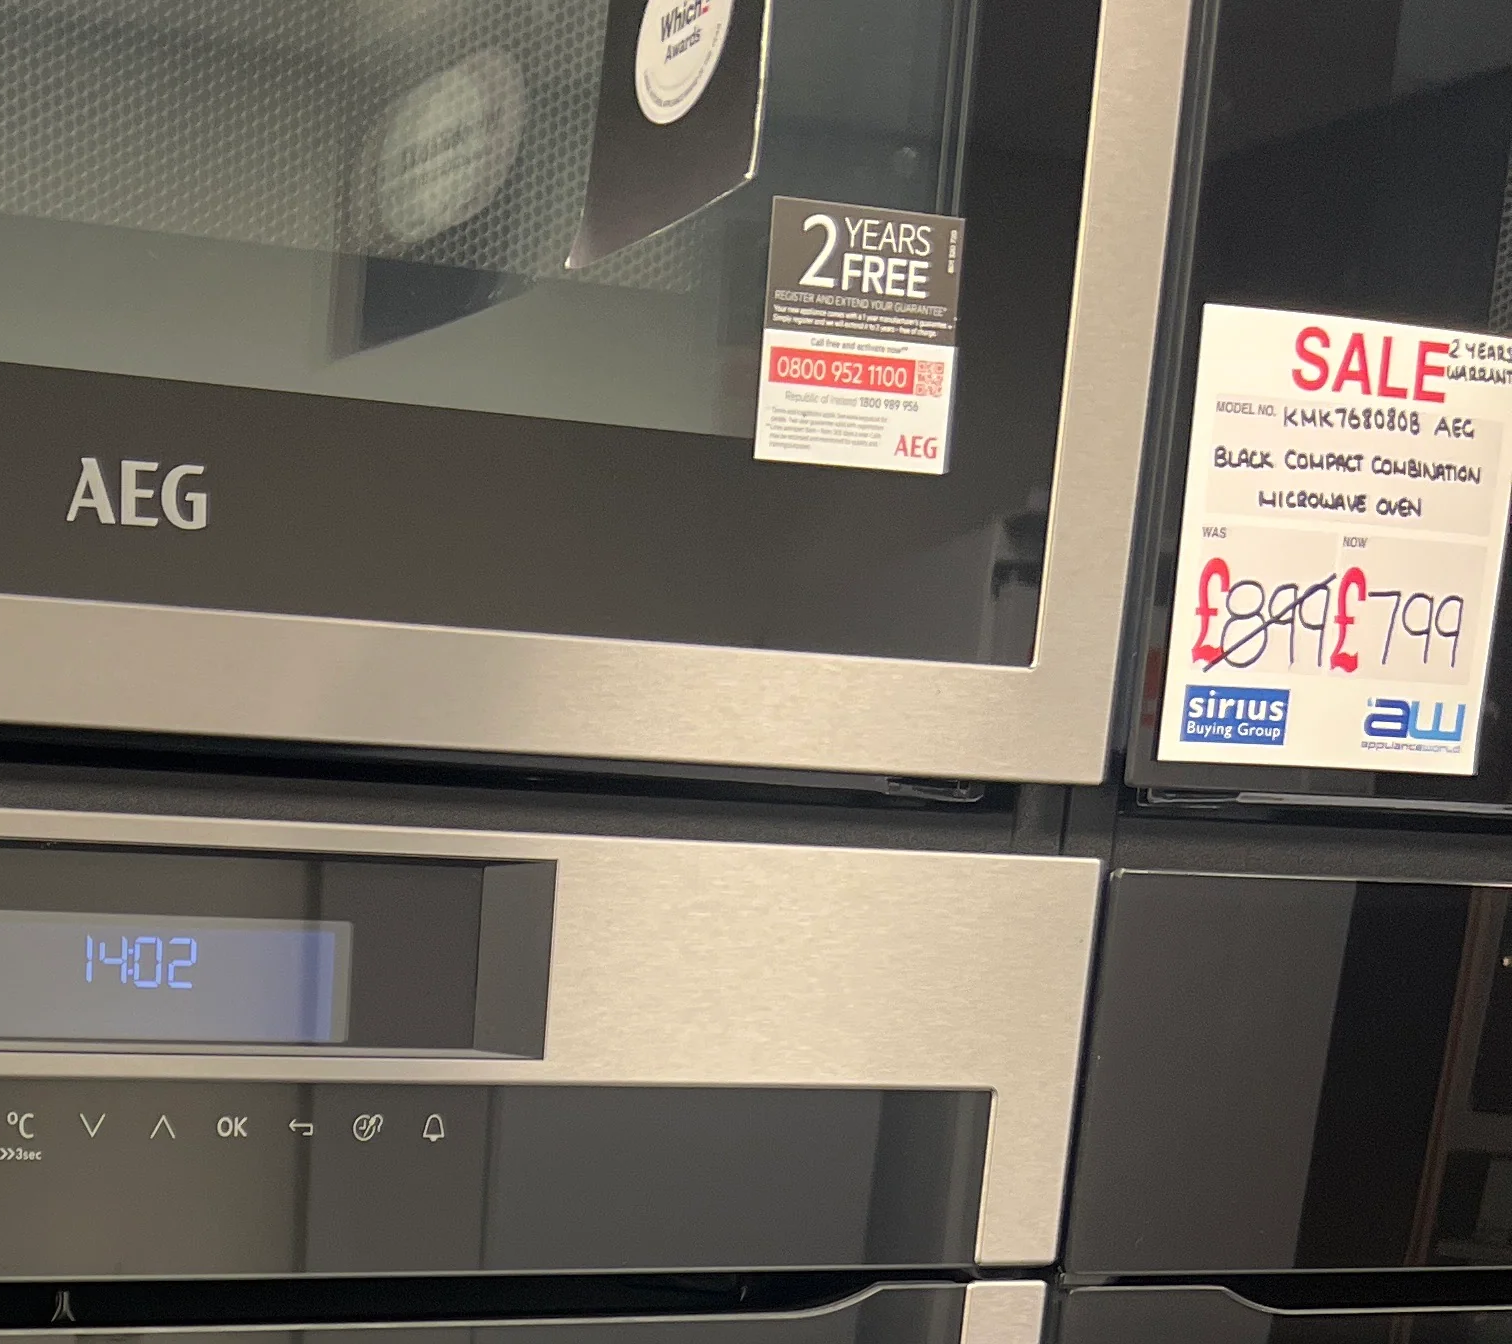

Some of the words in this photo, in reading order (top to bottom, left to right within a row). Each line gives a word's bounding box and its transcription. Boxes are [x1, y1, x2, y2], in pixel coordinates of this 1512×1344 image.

[798, 212, 838, 289] 2
[844, 216, 932, 257] YEARS
[841, 252, 931, 300] FREE
[776, 355, 826, 381] 0800
[831, 361, 864, 385] 952
[867, 365, 908, 388] 1100
[1291, 326, 1450, 404] SALE
[893, 434, 938, 460] AEG
[1213, 445, 1274, 471] BLACK
[1284, 448, 1364, 474] COMPACT
[1370, 455, 1482, 486] COMBINATION
[65, 458, 210, 531] AEG
[1375, 497, 1423, 518] OVEN
[1201, 526, 1227, 539] WAS
[1342, 536, 1369, 549] NOW
[1187, 689, 1285, 723] sirius
[1186, 720, 1233, 740] Buying
[1237, 723, 1281, 741] Group
[216, 1115, 248, 1139] OK
[14, 1146, 43, 1163] 3sec
